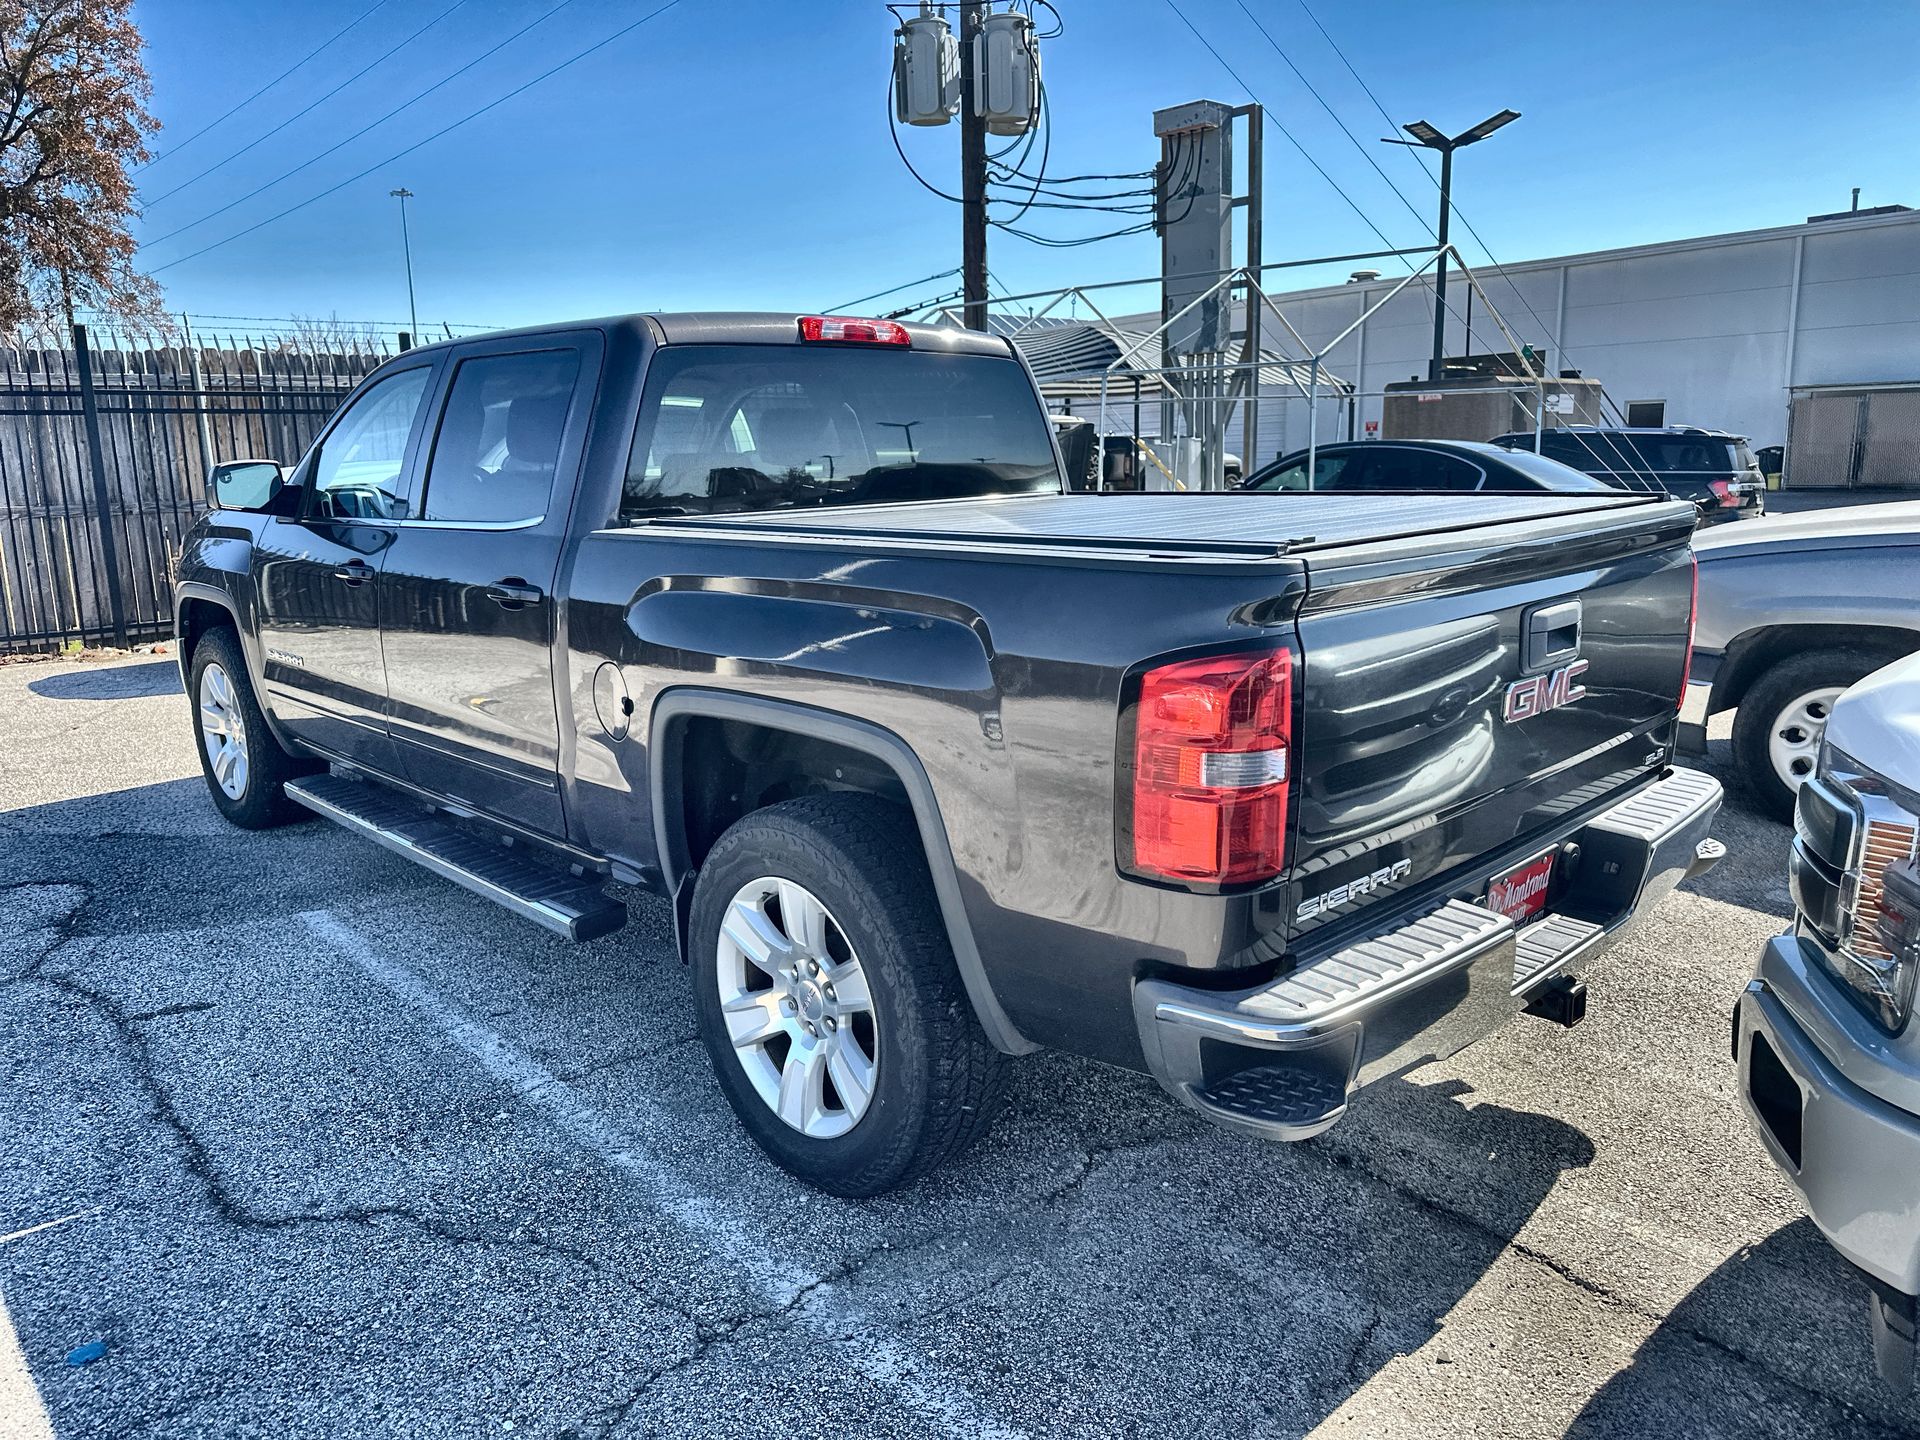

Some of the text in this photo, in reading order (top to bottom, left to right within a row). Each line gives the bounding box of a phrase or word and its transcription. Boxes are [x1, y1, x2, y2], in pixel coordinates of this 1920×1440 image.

[268, 649, 304, 667] SIERRA
[1504, 659, 1589, 723] GMC
[1296, 858, 1411, 924] SIERRA
